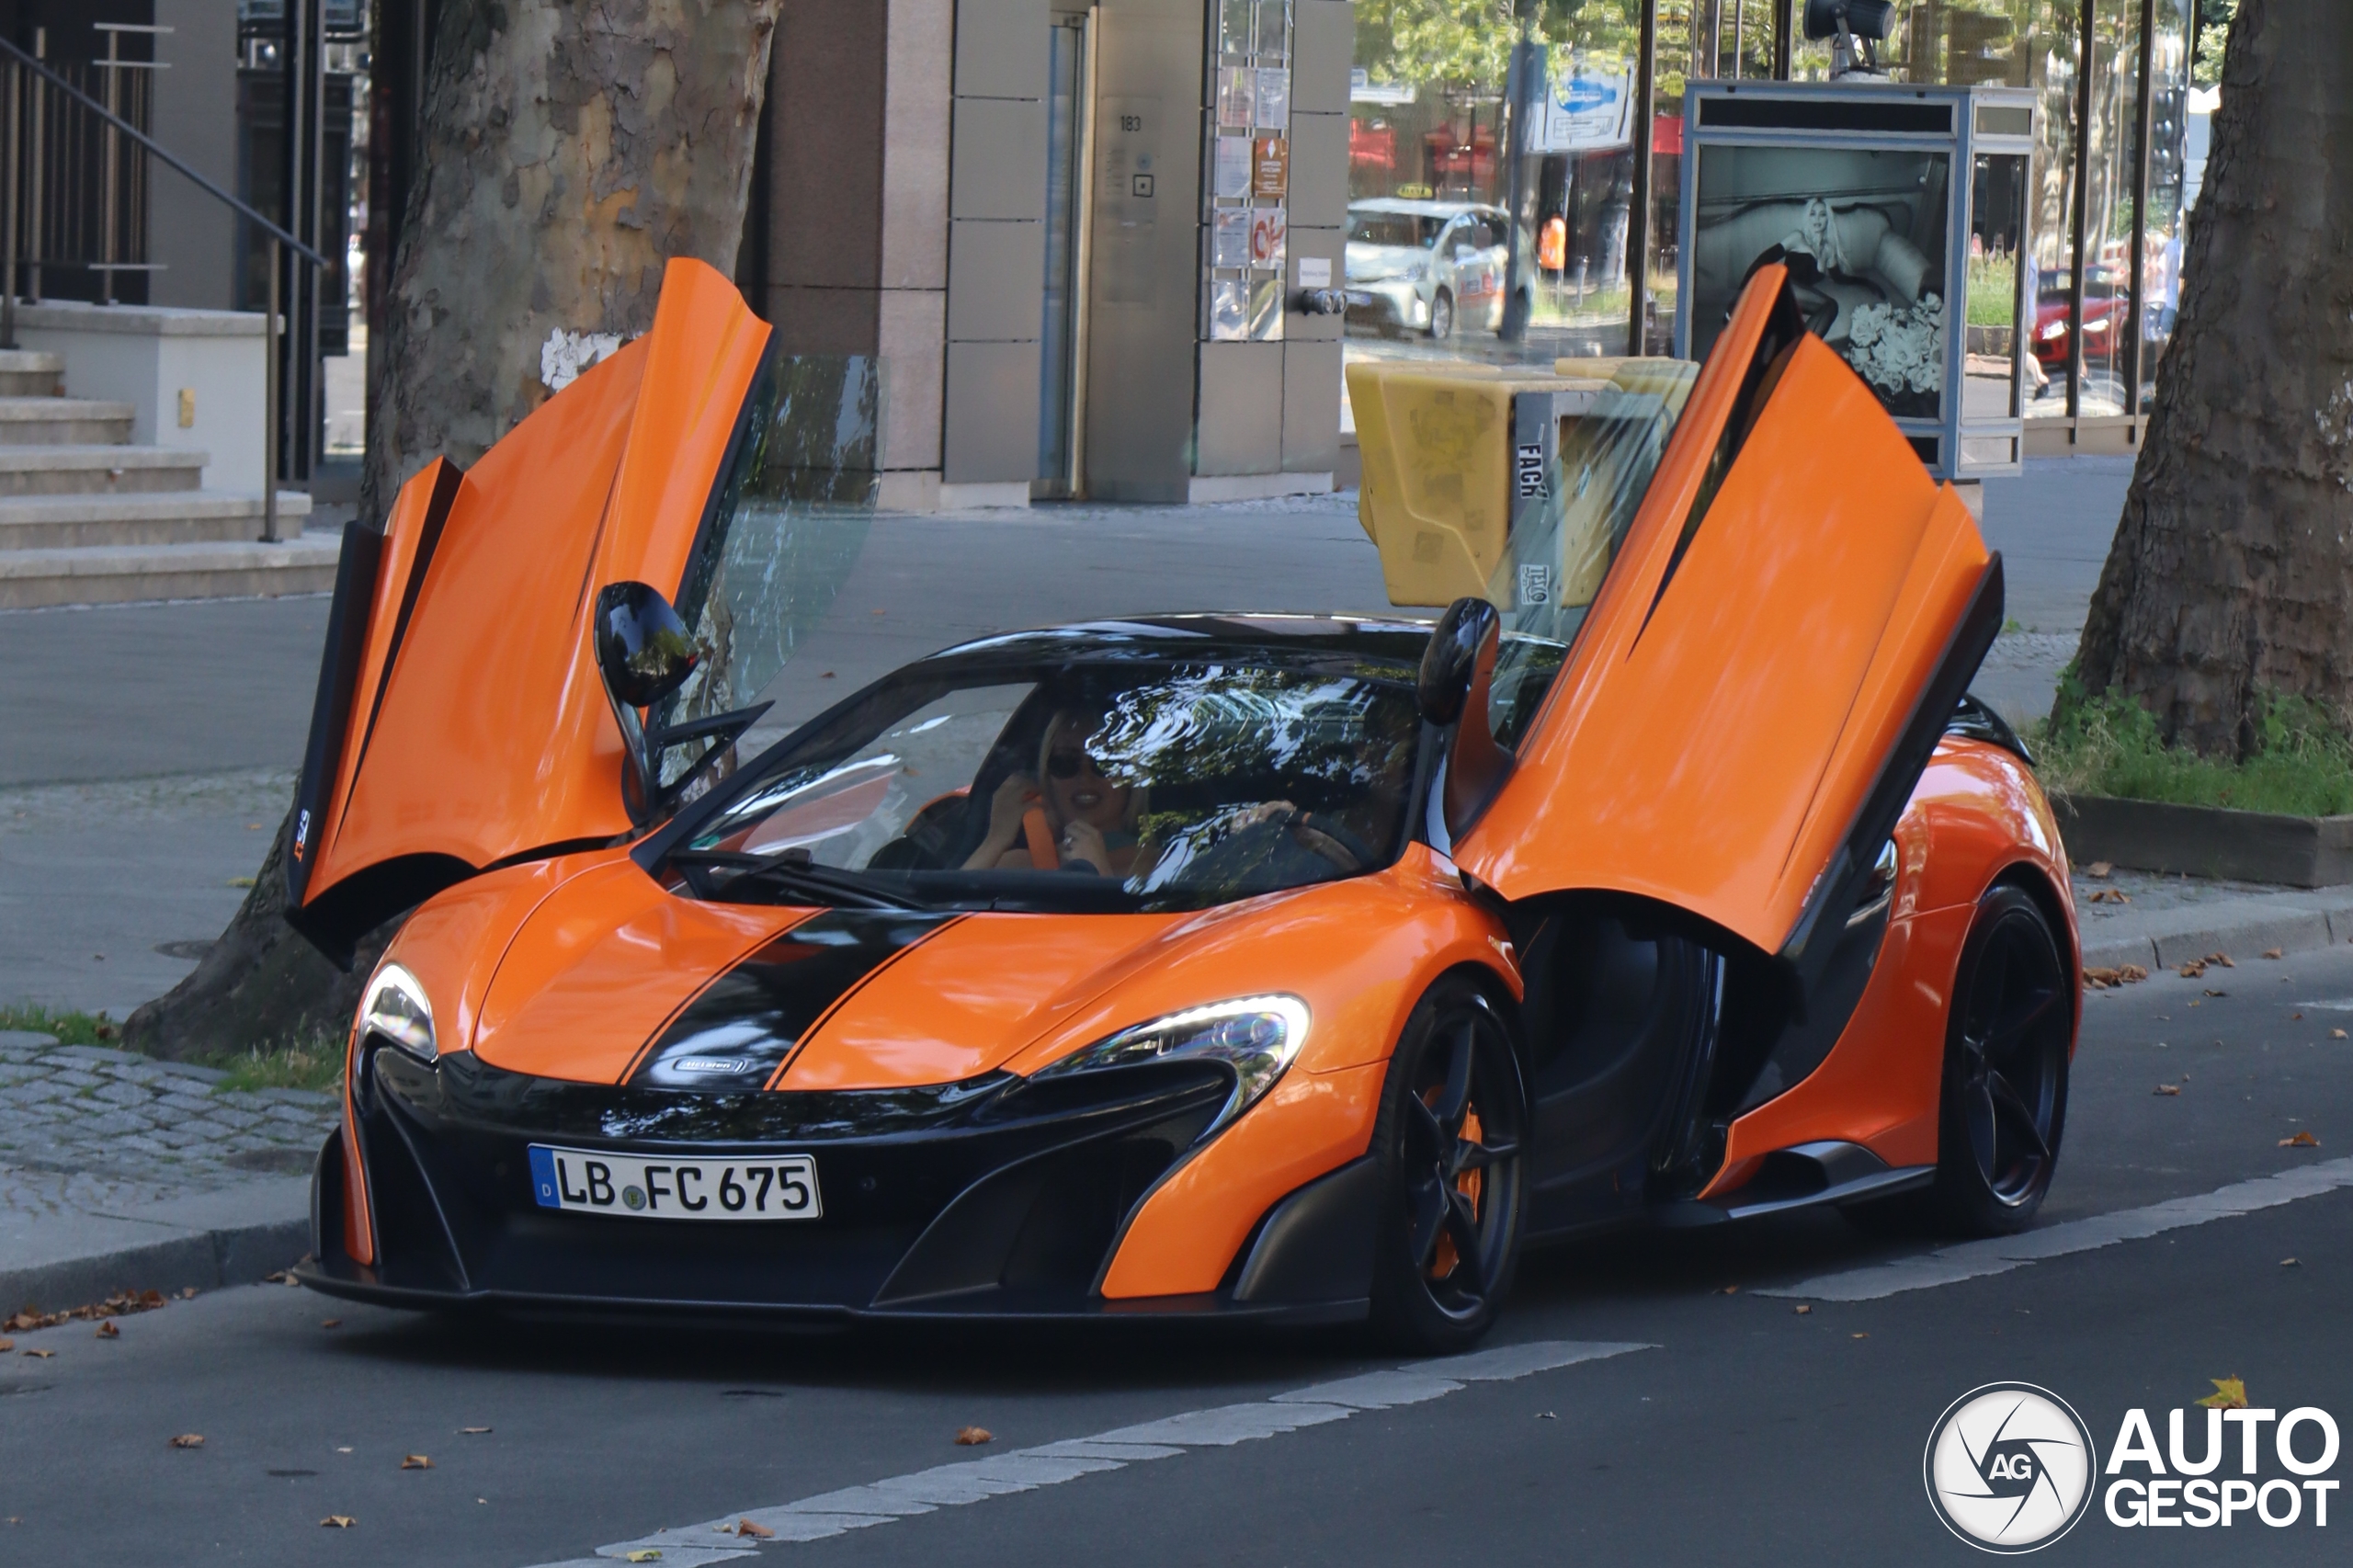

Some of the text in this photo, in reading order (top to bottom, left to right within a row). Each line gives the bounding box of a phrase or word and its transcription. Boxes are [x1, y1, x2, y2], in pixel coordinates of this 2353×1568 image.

[1120, 115, 1141, 131] 183
[541, 1158, 810, 1211] D LB FC 675
